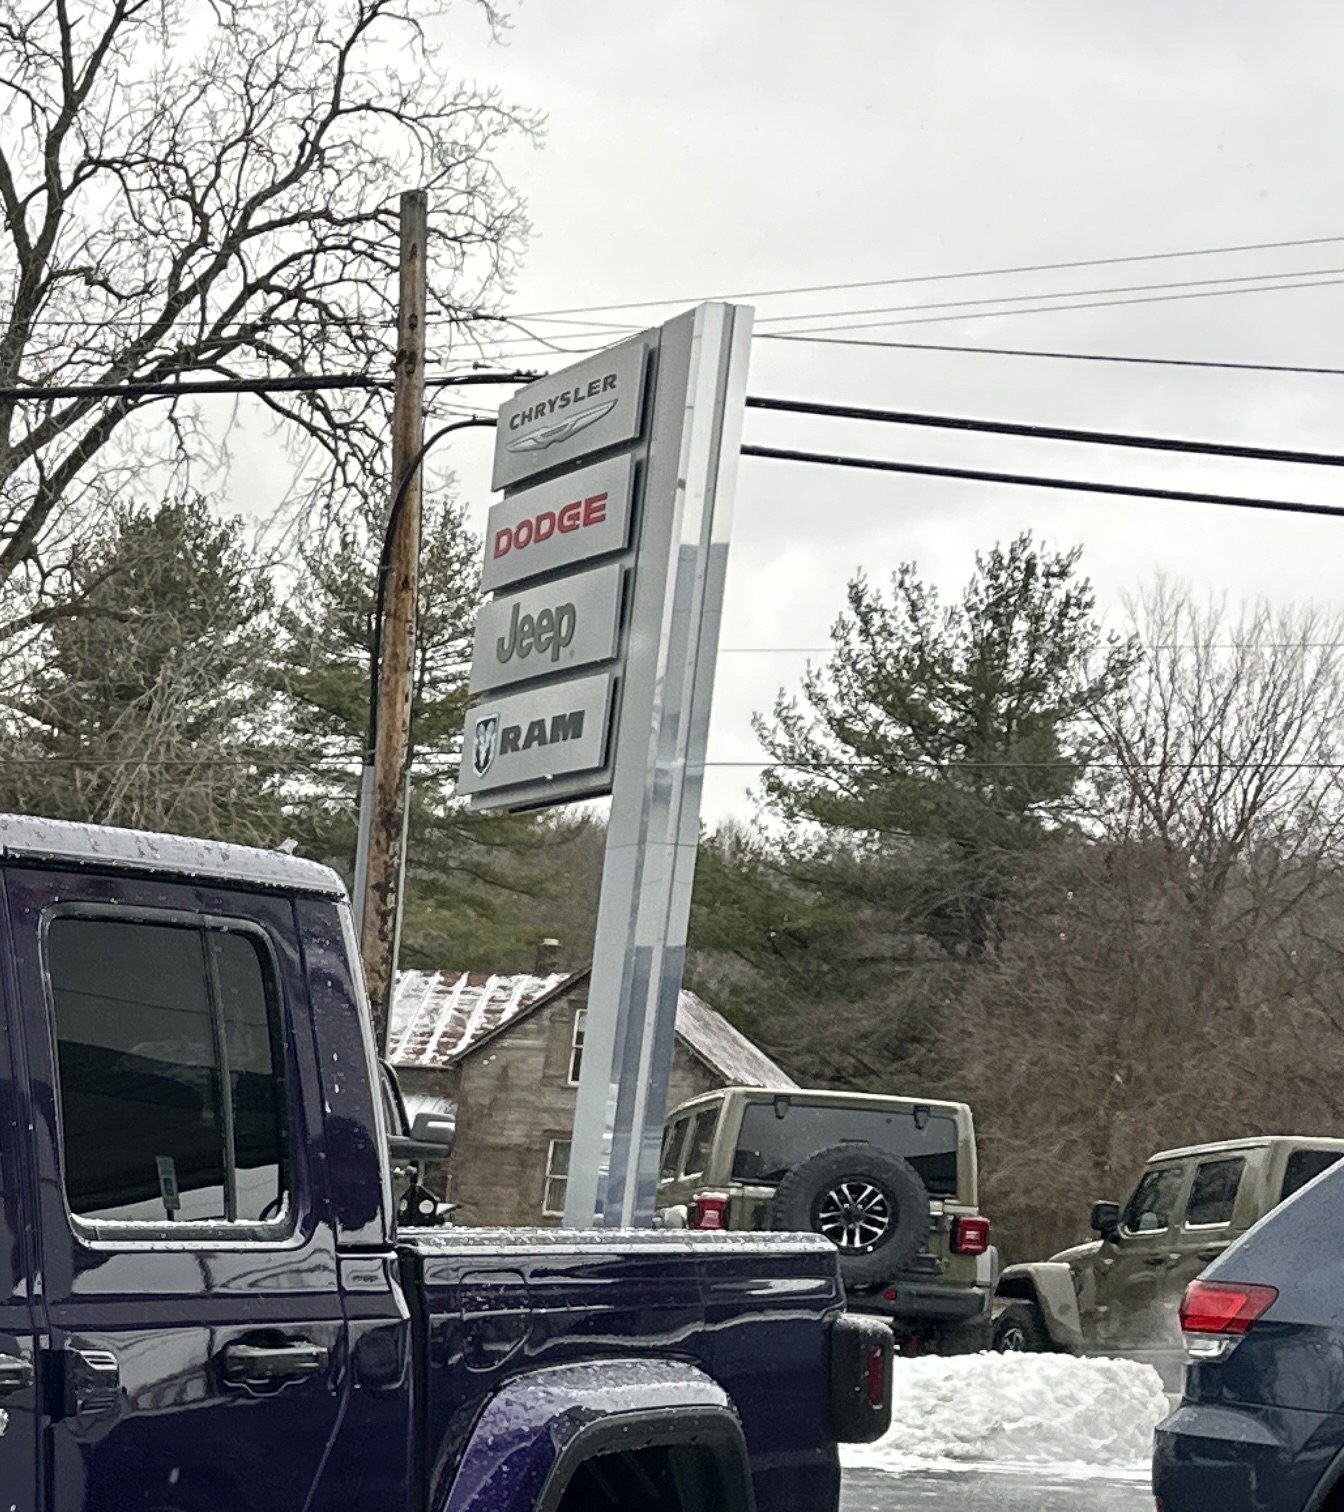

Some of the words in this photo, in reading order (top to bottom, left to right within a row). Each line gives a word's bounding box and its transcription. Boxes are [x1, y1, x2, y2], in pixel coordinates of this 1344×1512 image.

[508, 373, 618, 431] CHRYSLER
[494, 492, 609, 559] DODGE
[496, 601, 576, 663] Jeep
[500, 709, 586, 755] RAM
